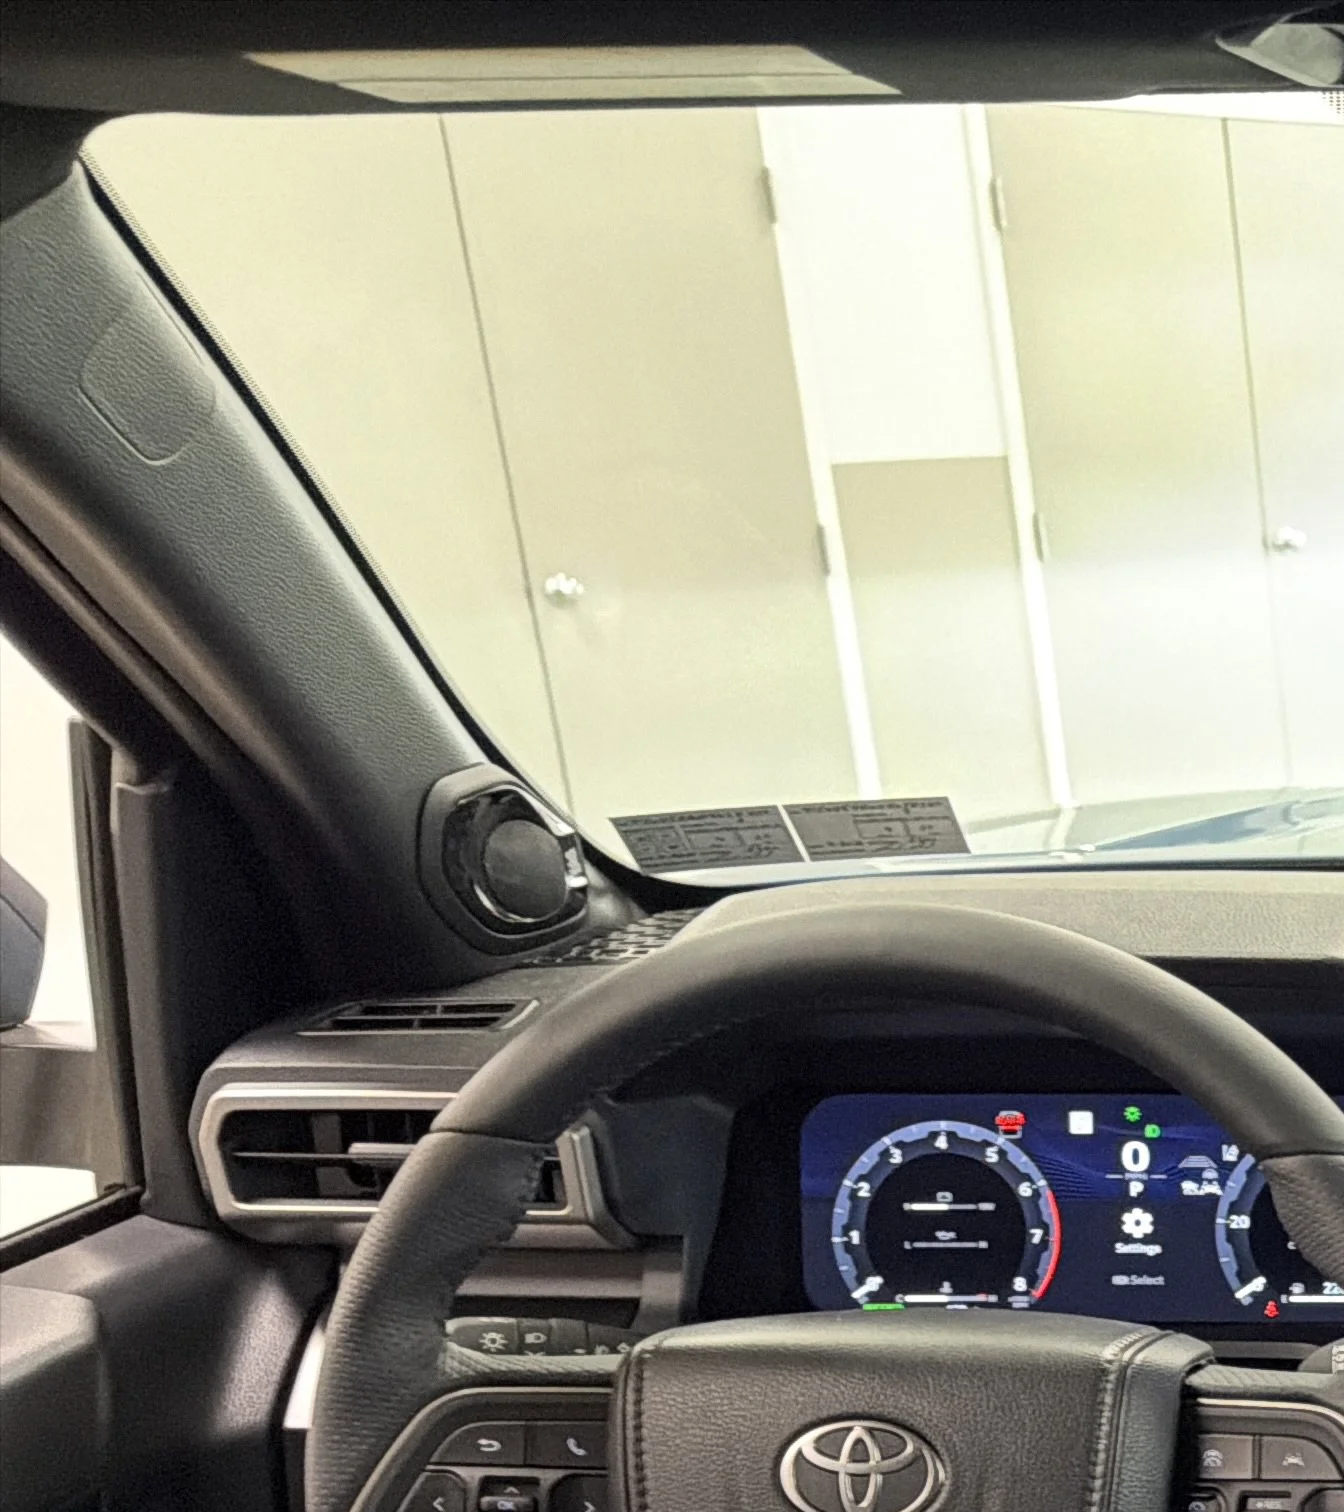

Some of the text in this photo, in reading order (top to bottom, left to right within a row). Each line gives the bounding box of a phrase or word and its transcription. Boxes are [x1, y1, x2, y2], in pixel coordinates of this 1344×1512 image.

[934, 1132, 949, 1150] 4
[889, 1148, 903, 1164] 3
[985, 1146, 999, 1163] 5
[1121, 1141, 1150, 1172] 0
[857, 1182, 871, 1197] 2
[1018, 1182, 1032, 1197] 6
[1129, 1181, 1144, 1197] P
[1229, 1215, 1250, 1229] 20
[849, 1230, 861, 1245] 1
[1029, 1229, 1044, 1244] 7
[1114, 1243, 1162, 1257] Settings
[1012, 1276, 1028, 1293] 8
[1131, 1275, 1165, 1286] Select
